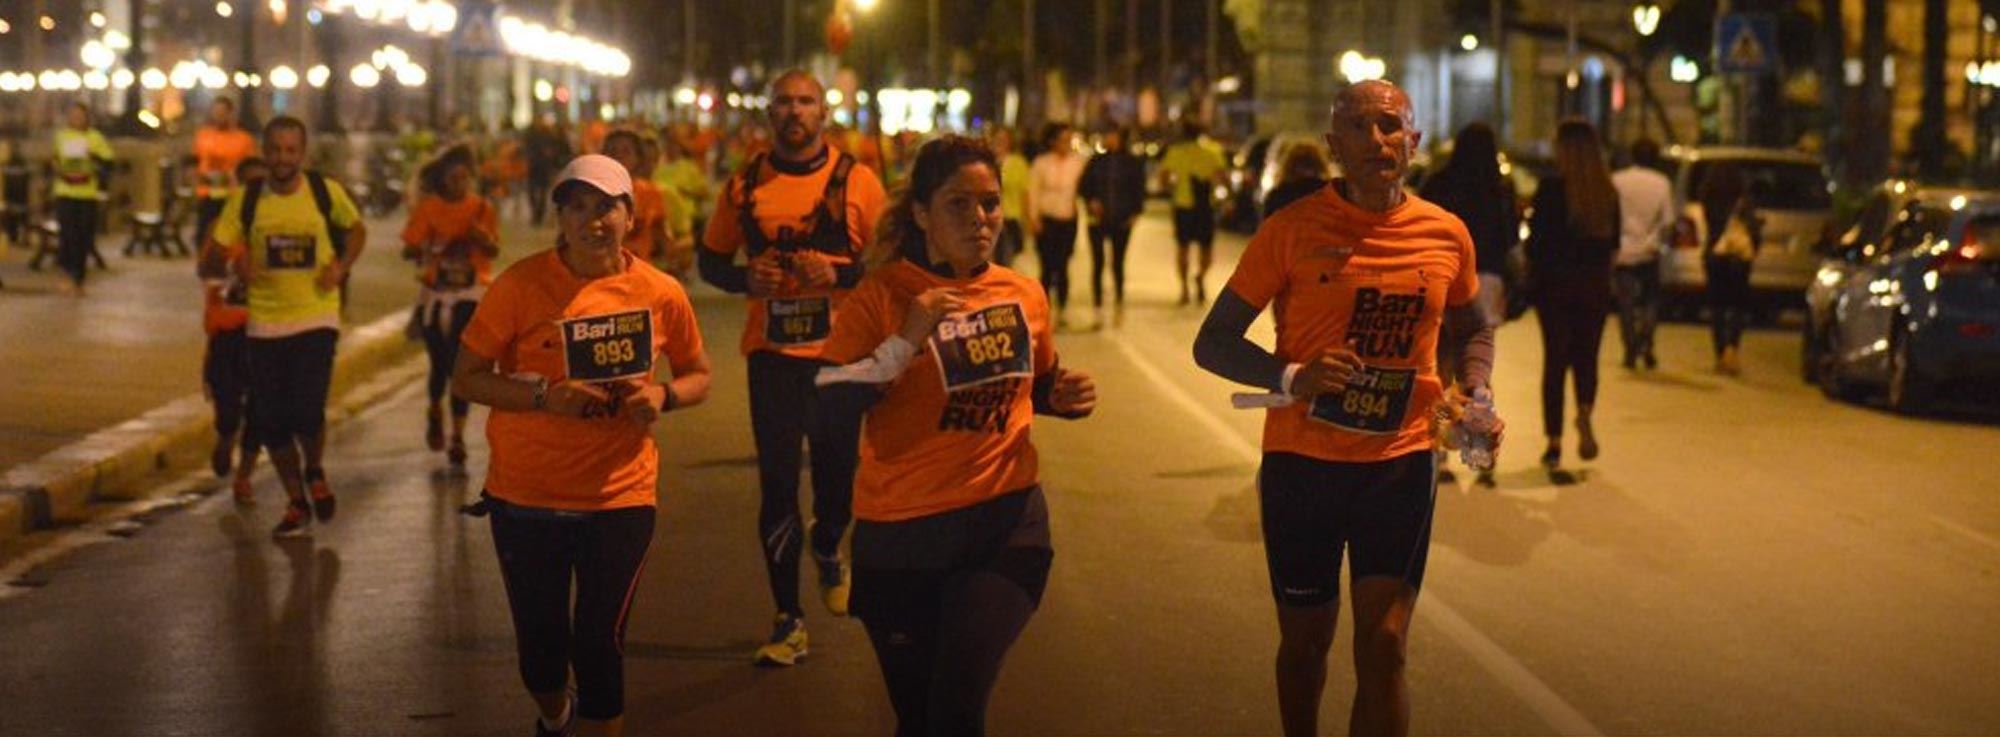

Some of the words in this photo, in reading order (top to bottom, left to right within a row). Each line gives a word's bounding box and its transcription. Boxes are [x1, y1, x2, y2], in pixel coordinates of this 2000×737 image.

[1355, 287, 1426, 314] Bari
[573, 318, 615, 341] Bari
[1348, 312, 1421, 334] NIGHT
[593, 339, 634, 365] 893
[966, 332, 1014, 364] 882
[1344, 390, 1388, 417] 894
